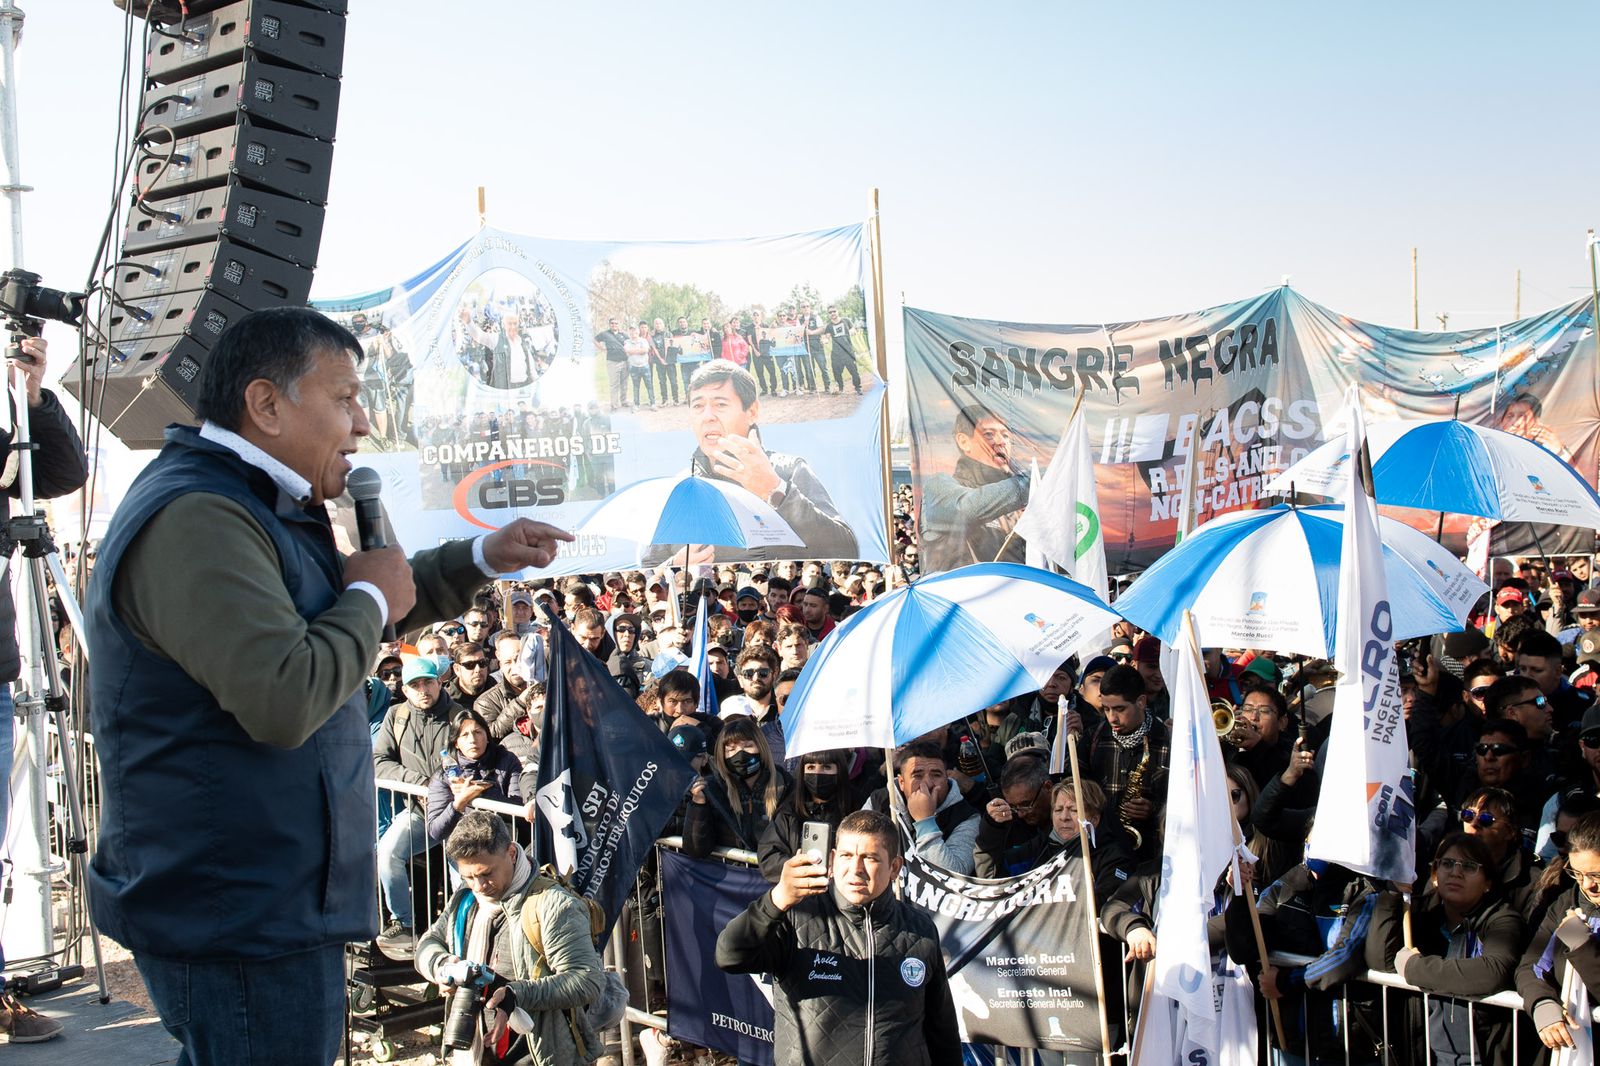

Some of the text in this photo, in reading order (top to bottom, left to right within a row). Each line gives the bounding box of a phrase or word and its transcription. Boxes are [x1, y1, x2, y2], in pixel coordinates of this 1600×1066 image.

[948, 317, 1280, 404] SANGRE NEGRA
[423, 433, 621, 465] COMPAÑEROS DE
[478, 478, 565, 509] CBS
[1382, 703, 1402, 745] PARA
[581, 782, 608, 818] SPJ
[607, 761, 658, 851] JERÁRQUICOS
[611, 790, 621, 812] DE
[986, 953, 1075, 967] Marcelo Rucci
[997, 966, 1067, 977] Secretario General
[989, 999, 1084, 1011] Secretario General Adjunto
[997, 986, 1072, 998] Ernesto Inal
